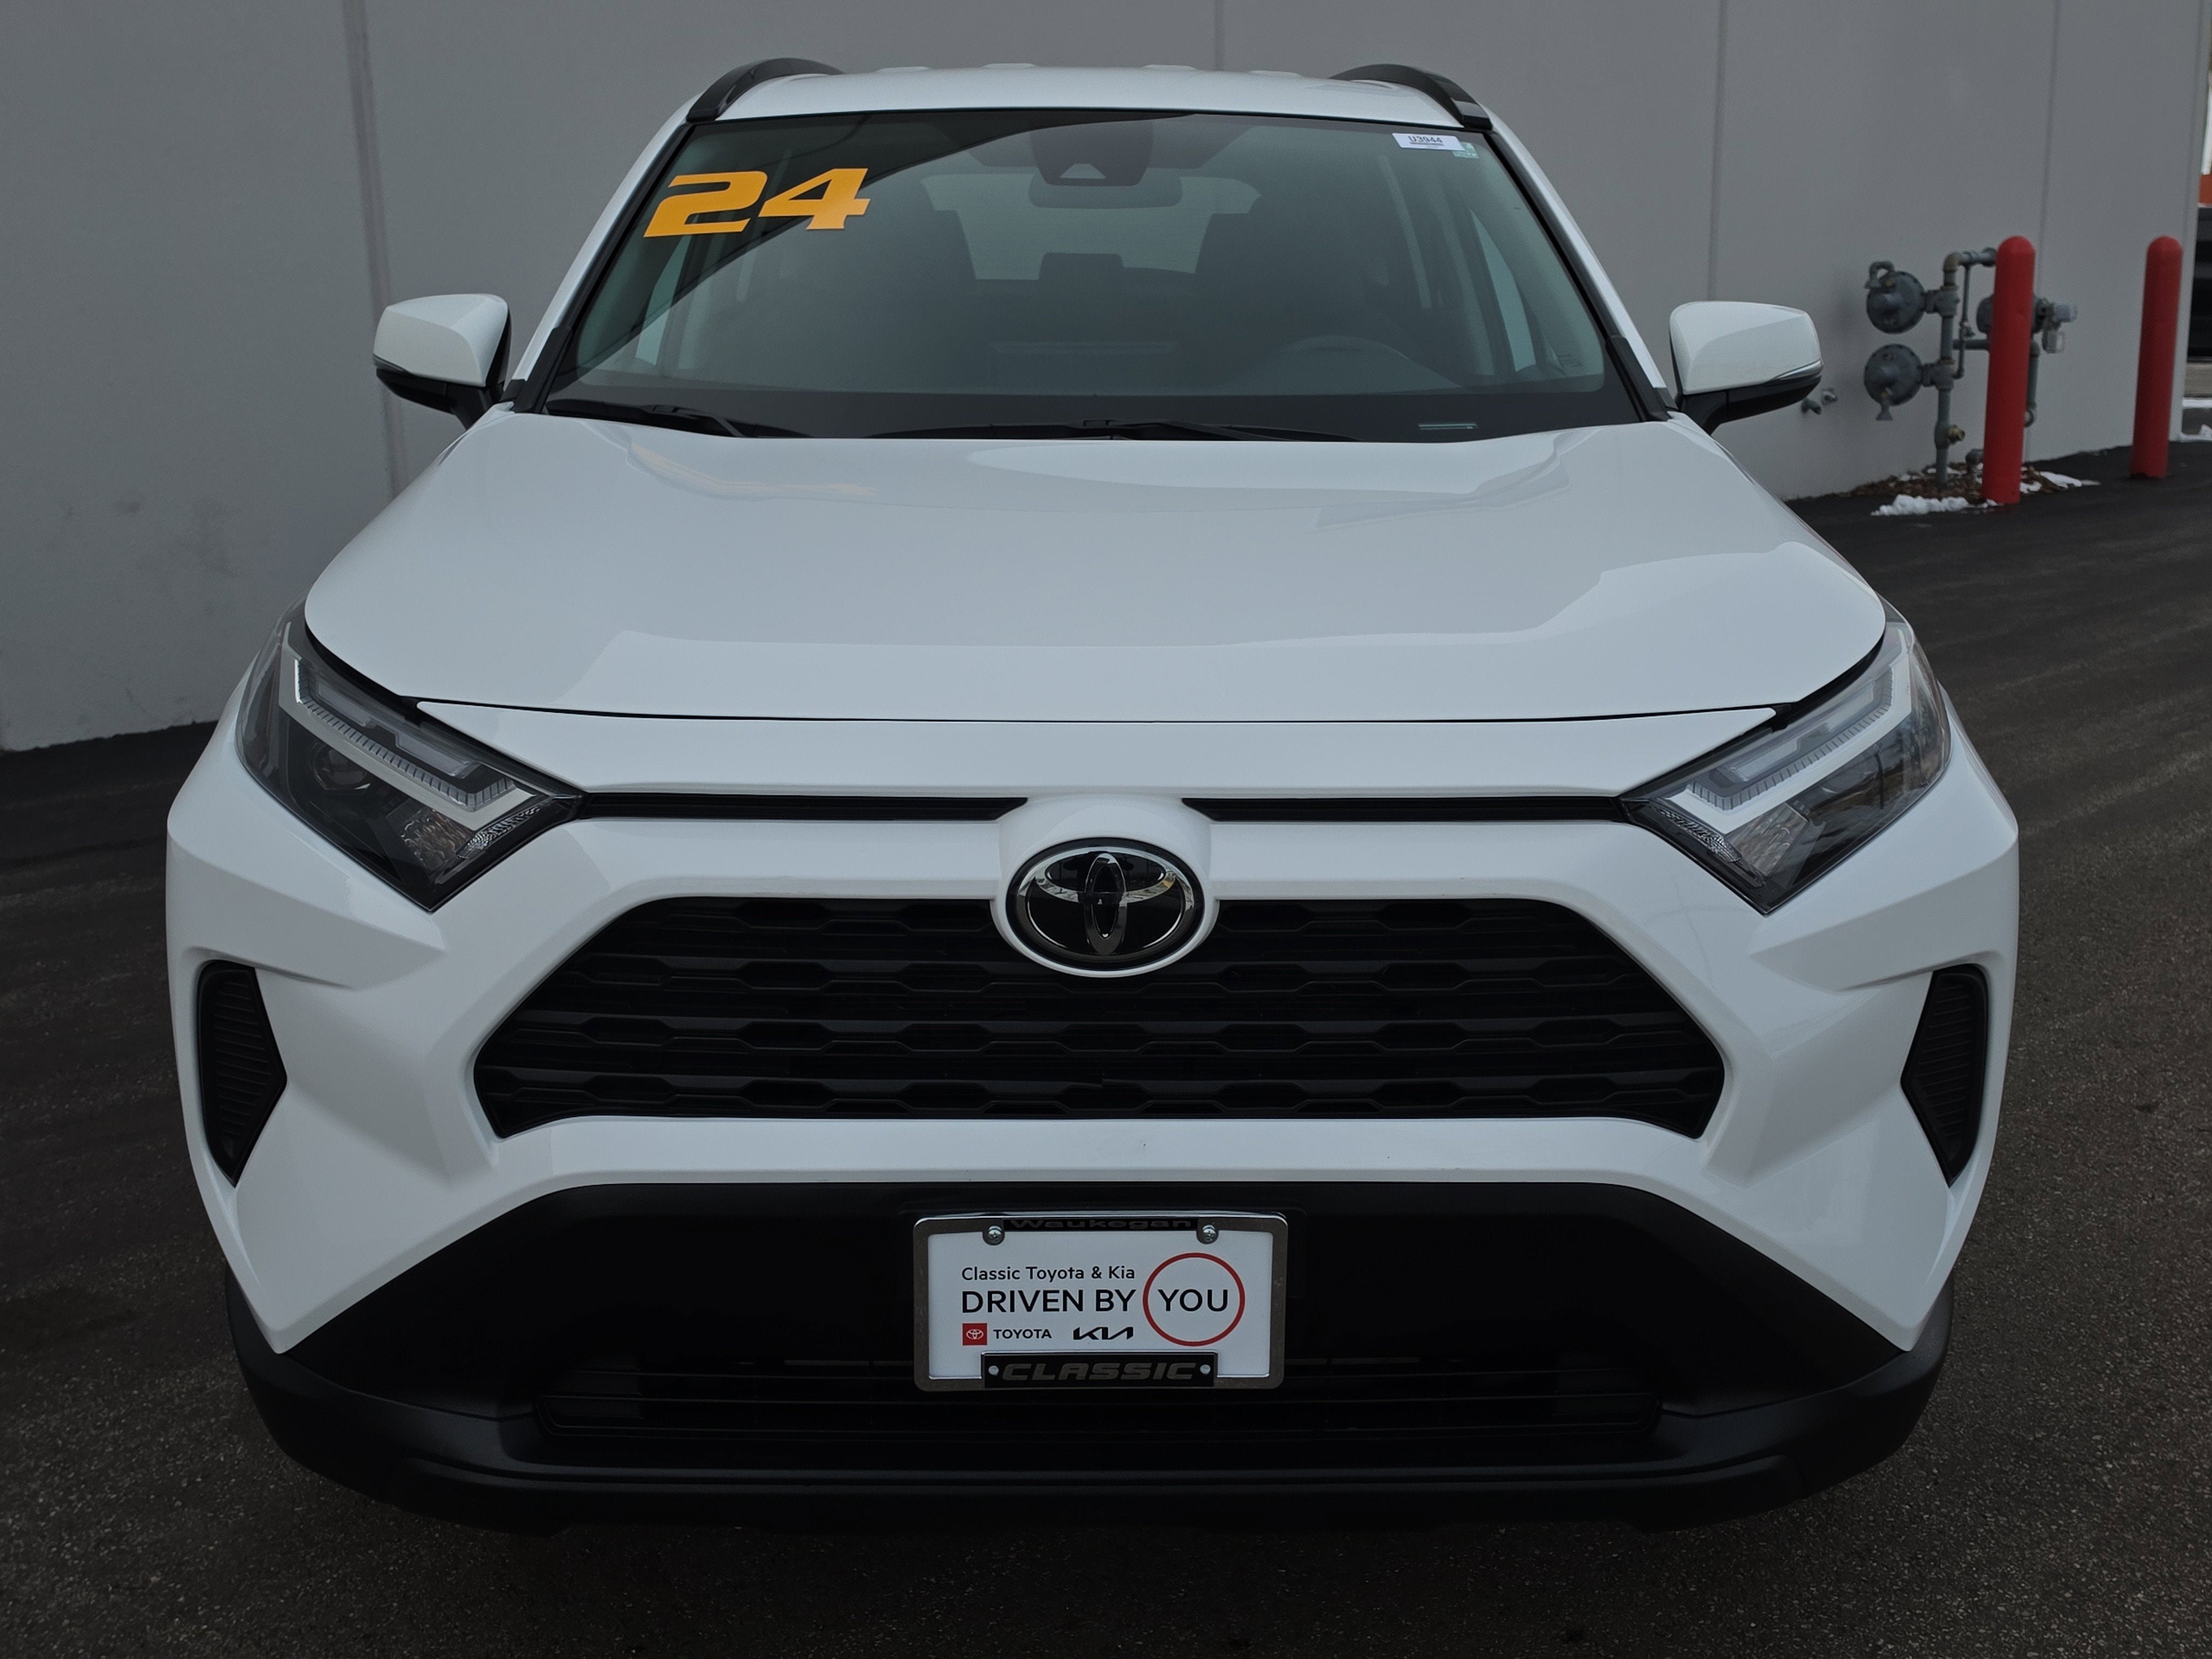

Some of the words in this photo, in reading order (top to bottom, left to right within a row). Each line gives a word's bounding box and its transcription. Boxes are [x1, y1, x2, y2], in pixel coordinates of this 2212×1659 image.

[644, 168, 871, 237] 24
[1011, 1219, 1192, 1230] Waukegan
[961, 1266, 1020, 1281] Classic
[1026, 1266, 1084, 1282] Toyota
[1091, 1266, 1102, 1279] &
[1109, 1266, 1135, 1279] Kia
[962, 1290, 1083, 1313] DRIVEN
[1095, 1289, 1136, 1311] BY
[1158, 1289, 1228, 1312] YOU
[993, 1329, 1052, 1339] TOYOTA
[1002, 1362, 1196, 1380] CLASSIC
